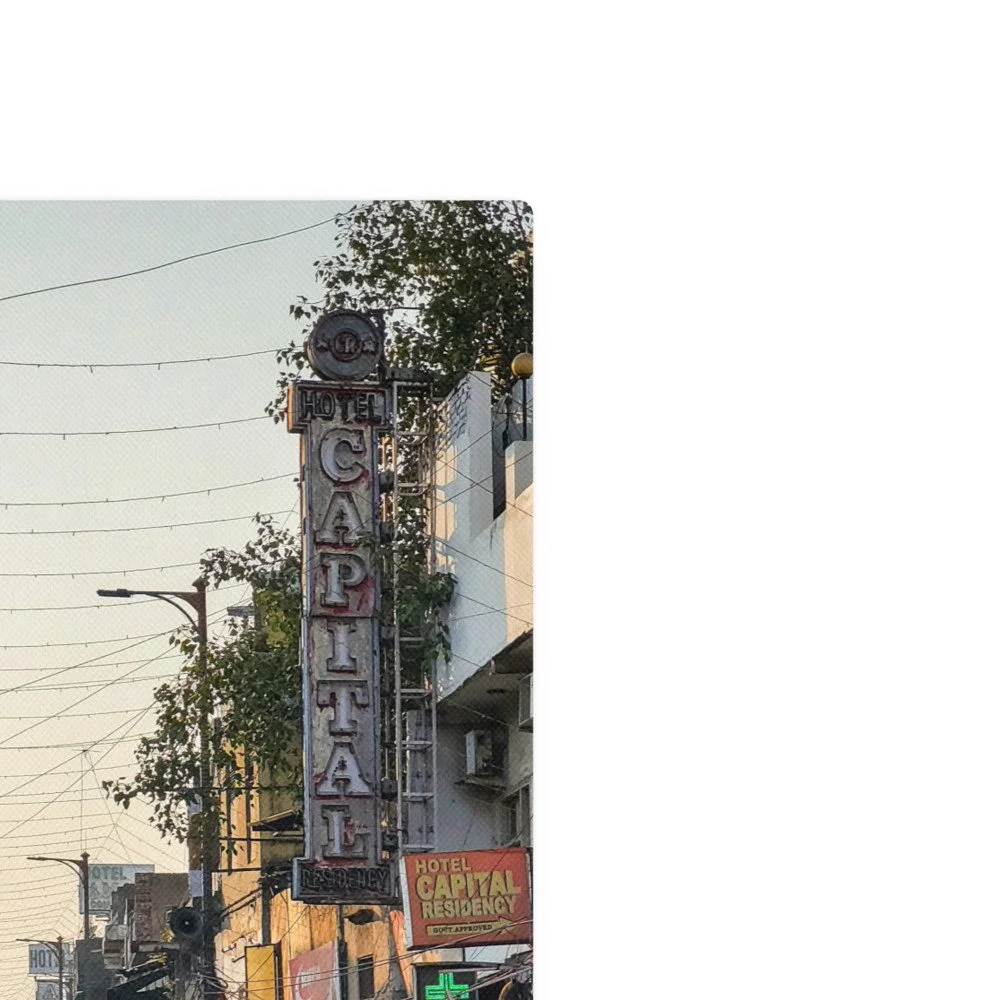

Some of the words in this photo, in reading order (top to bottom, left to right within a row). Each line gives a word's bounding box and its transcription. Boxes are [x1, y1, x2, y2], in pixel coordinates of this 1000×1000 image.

[301, 391, 382, 422] HOTEL
[315, 428, 372, 861] CAPITAL
[87, 866, 127, 880] OTEL
[415, 858, 471, 874] HOTEL
[302, 868, 387, 888] RESIDENCY
[416, 870, 521, 901] CAPITAL
[422, 895, 516, 919] RESIDENCY
[31, 949, 68, 969] HOT
